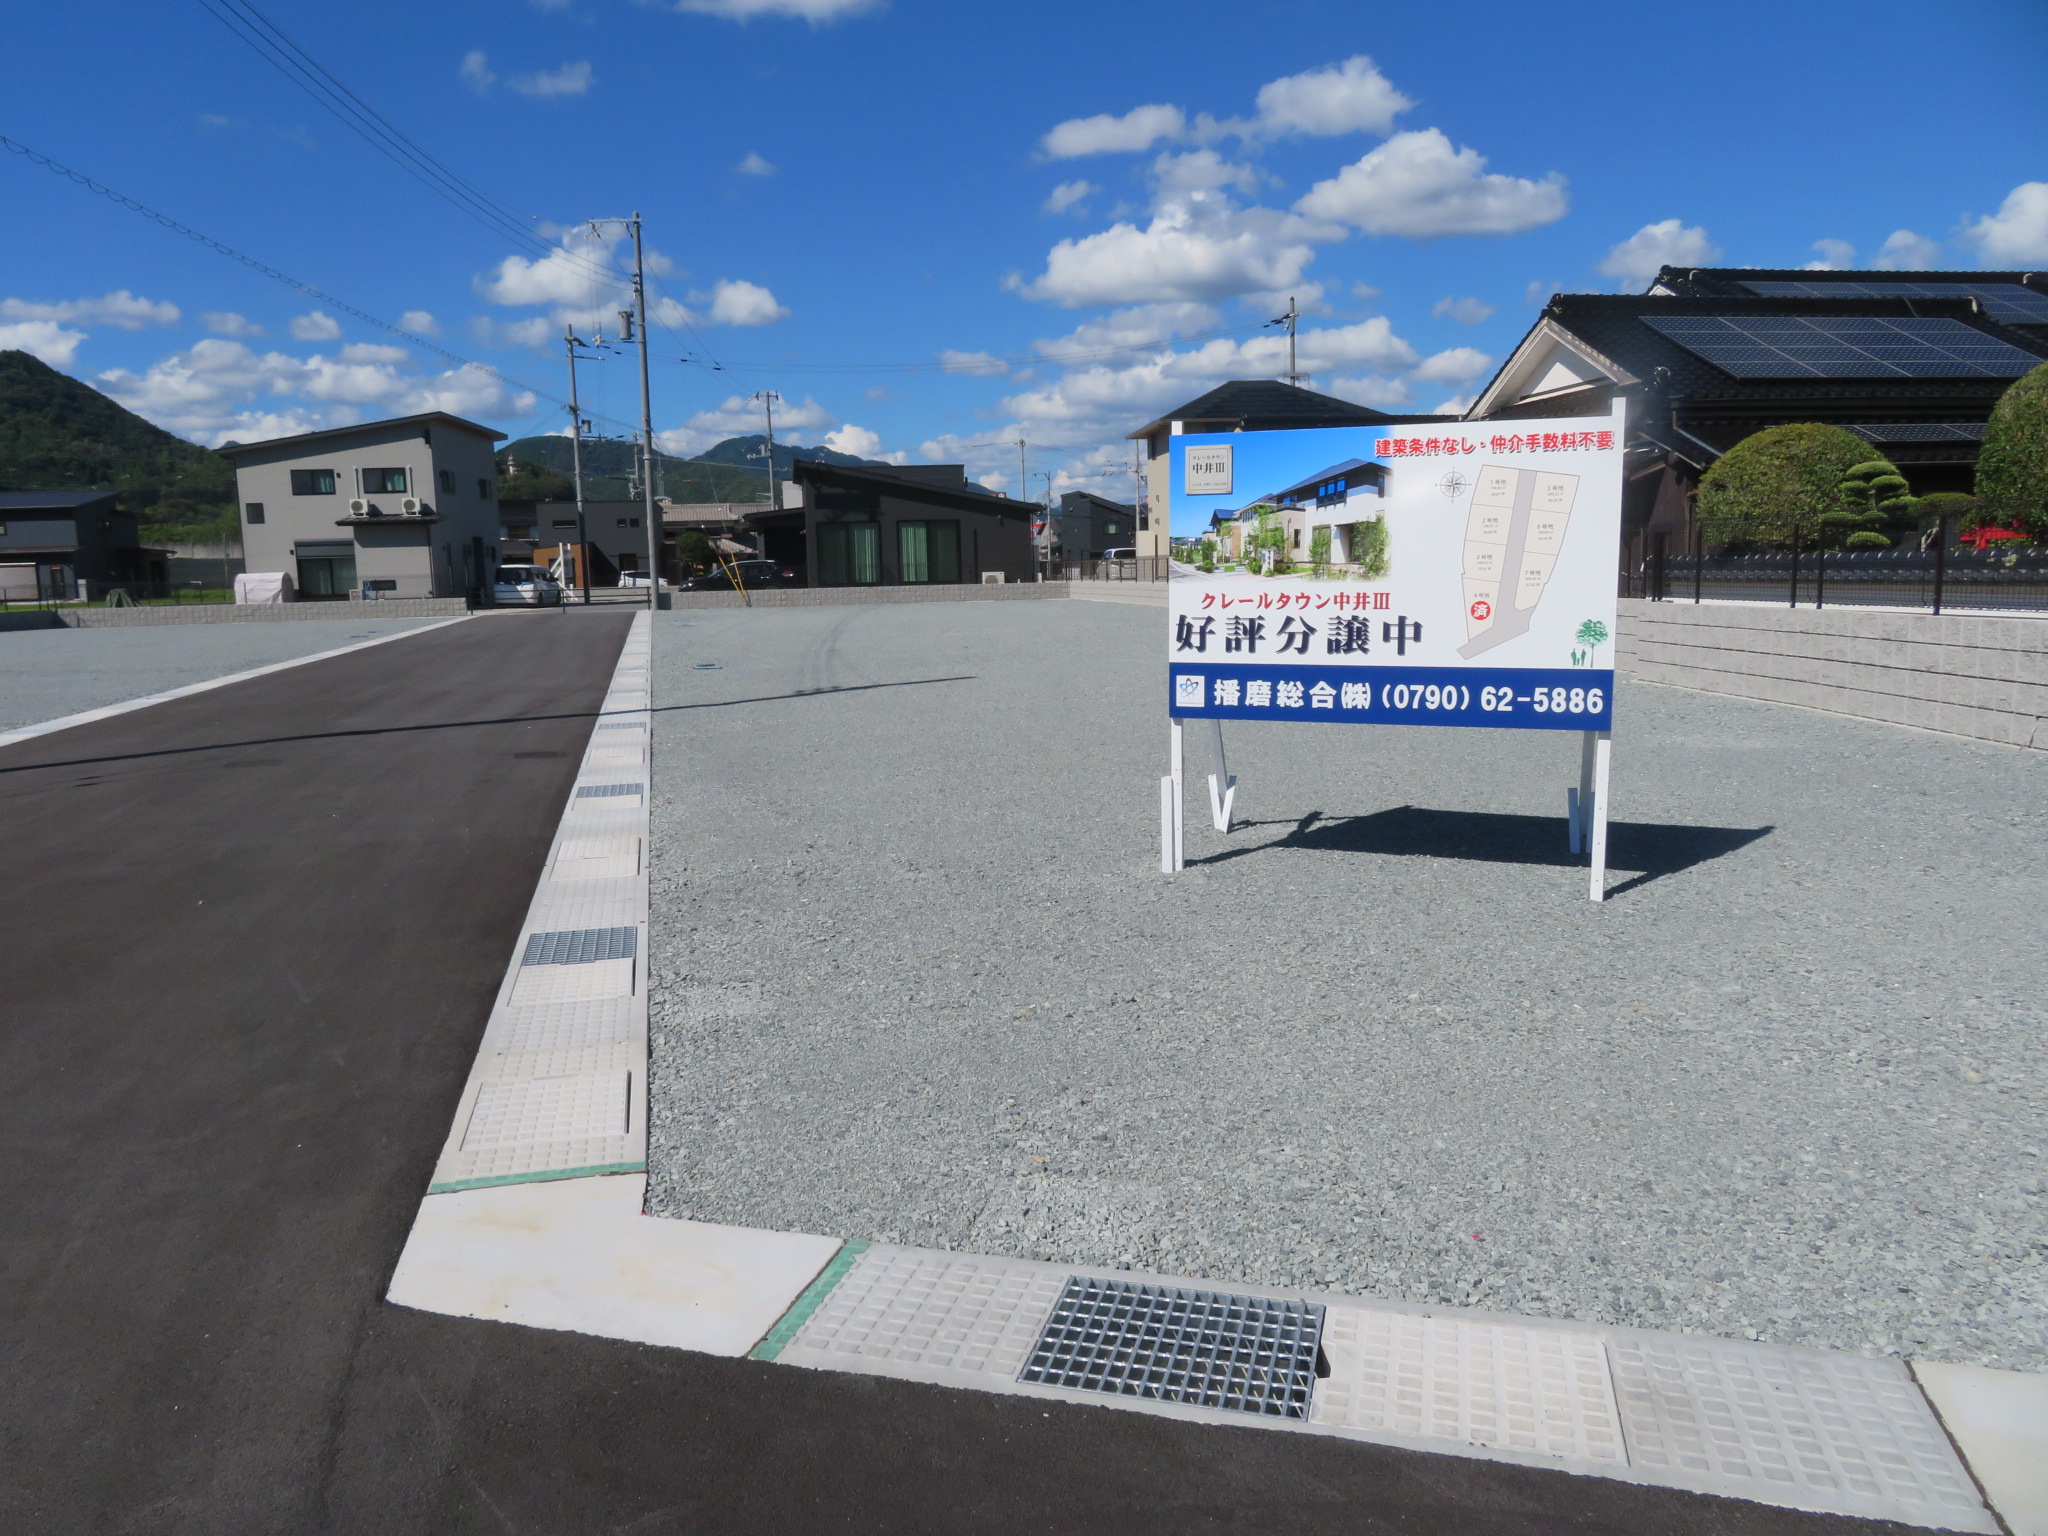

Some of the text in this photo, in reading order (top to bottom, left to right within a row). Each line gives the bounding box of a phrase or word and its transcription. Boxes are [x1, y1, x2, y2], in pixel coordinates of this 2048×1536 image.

[1375, 431, 1614, 457] 建築条件なし・仲介手数料不要
[1473, 603, 1488, 618] 済
[1175, 614, 1423, 656] 好評分譲中
[1480, 686, 1604, 714] 62-5886
